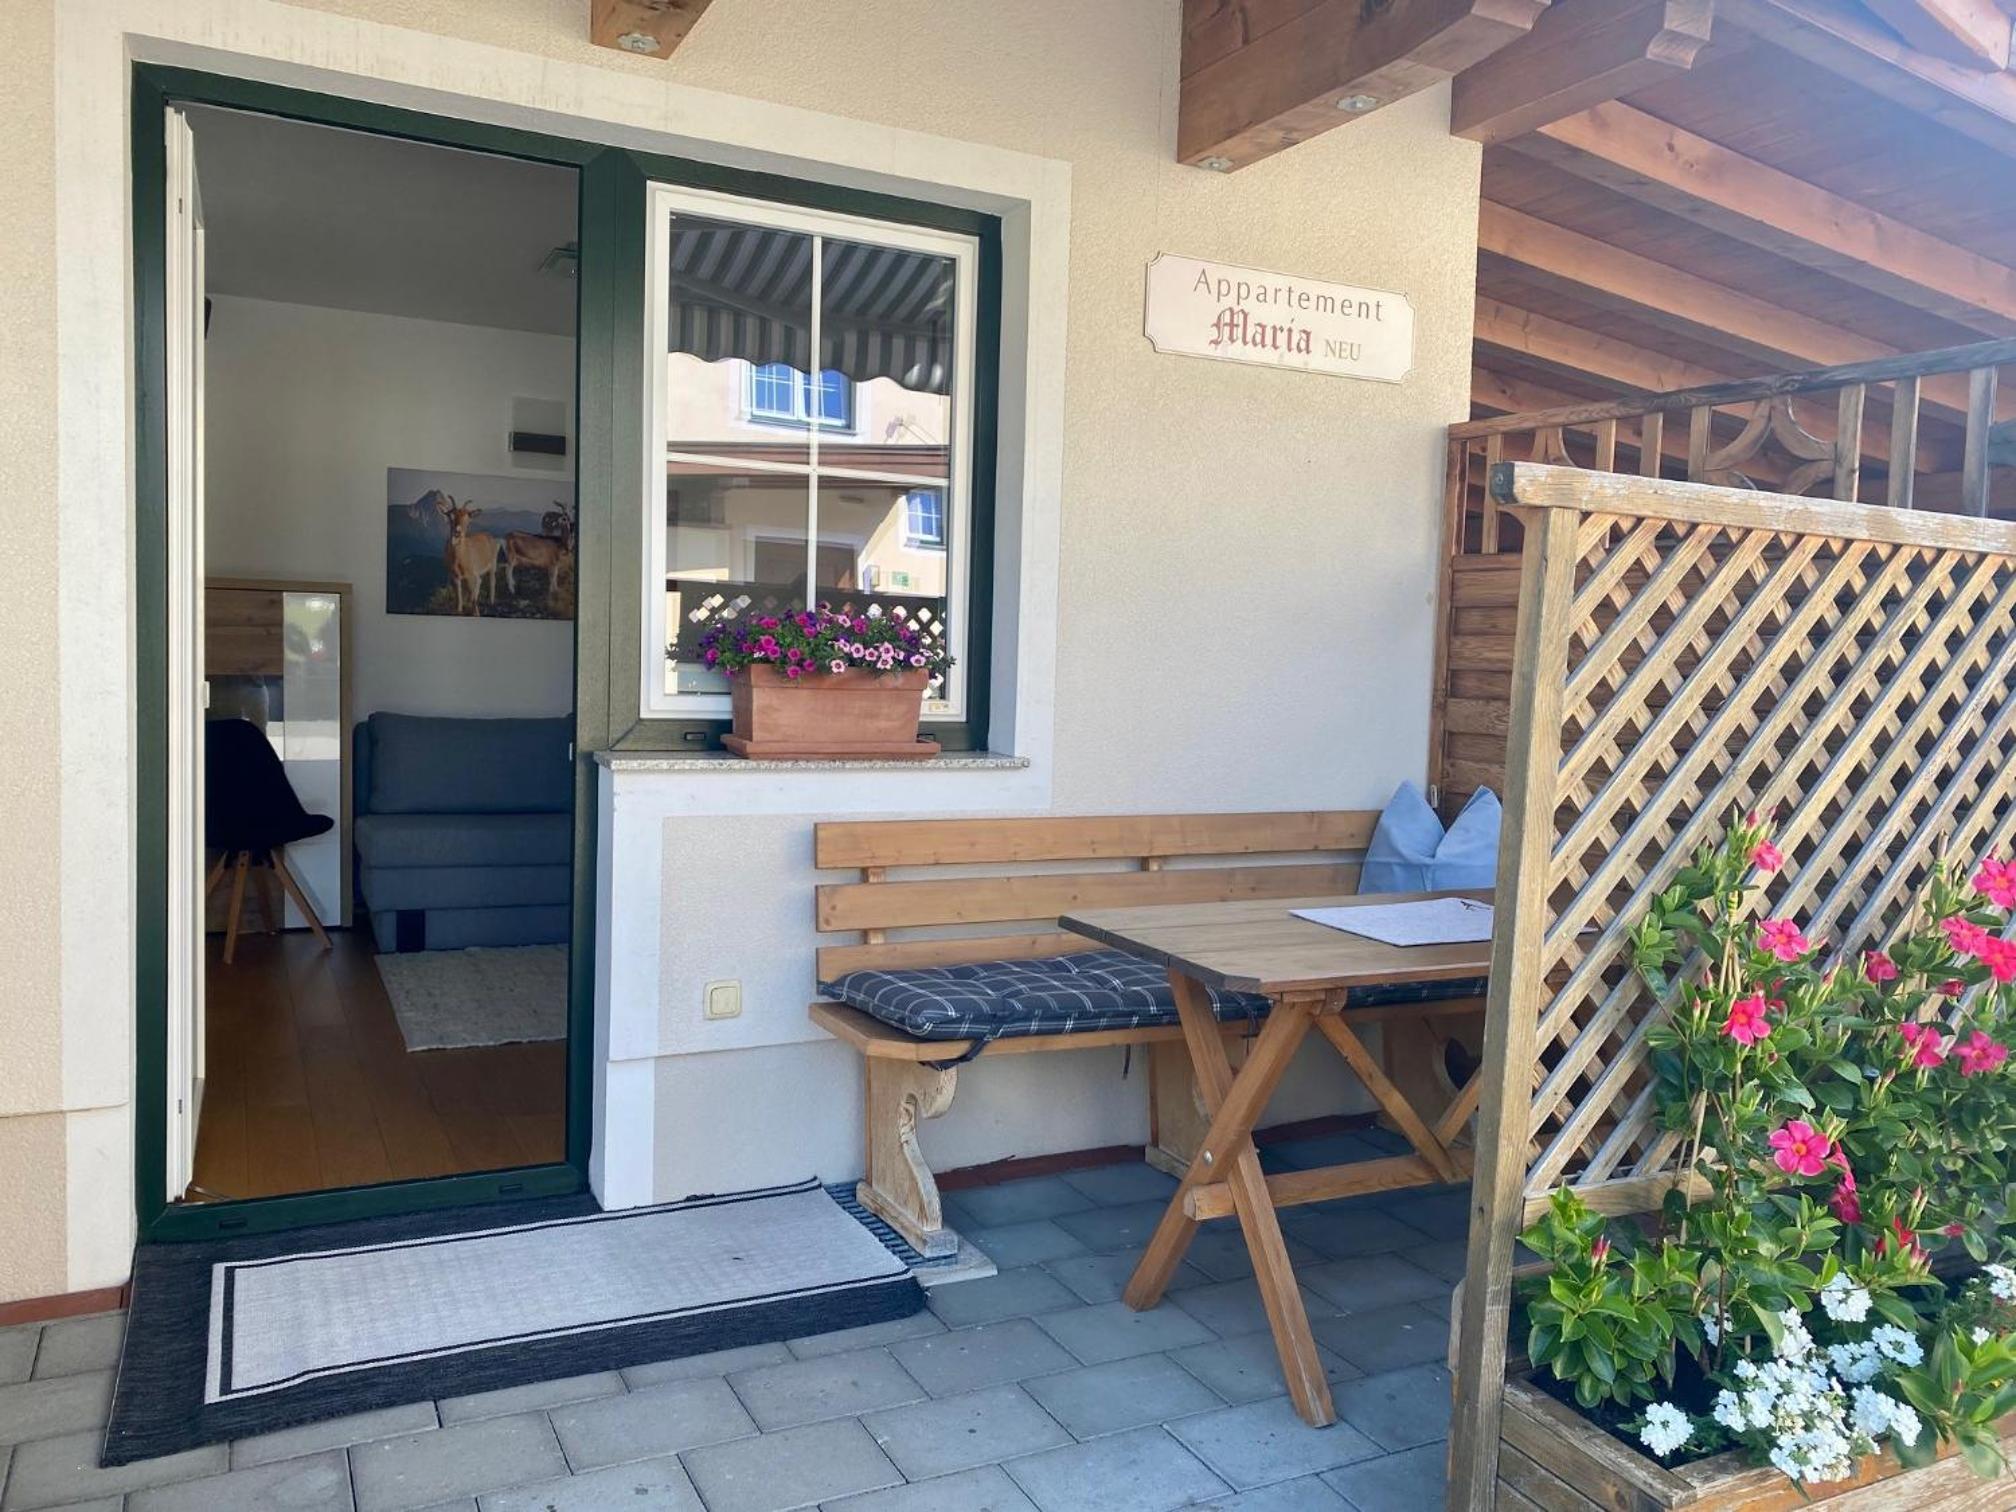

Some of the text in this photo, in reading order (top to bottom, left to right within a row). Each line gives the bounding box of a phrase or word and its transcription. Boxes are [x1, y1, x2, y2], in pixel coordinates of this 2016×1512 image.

[1194, 268, 1382, 321] Appartement
[1209, 307, 1361, 361] Maria NEU
